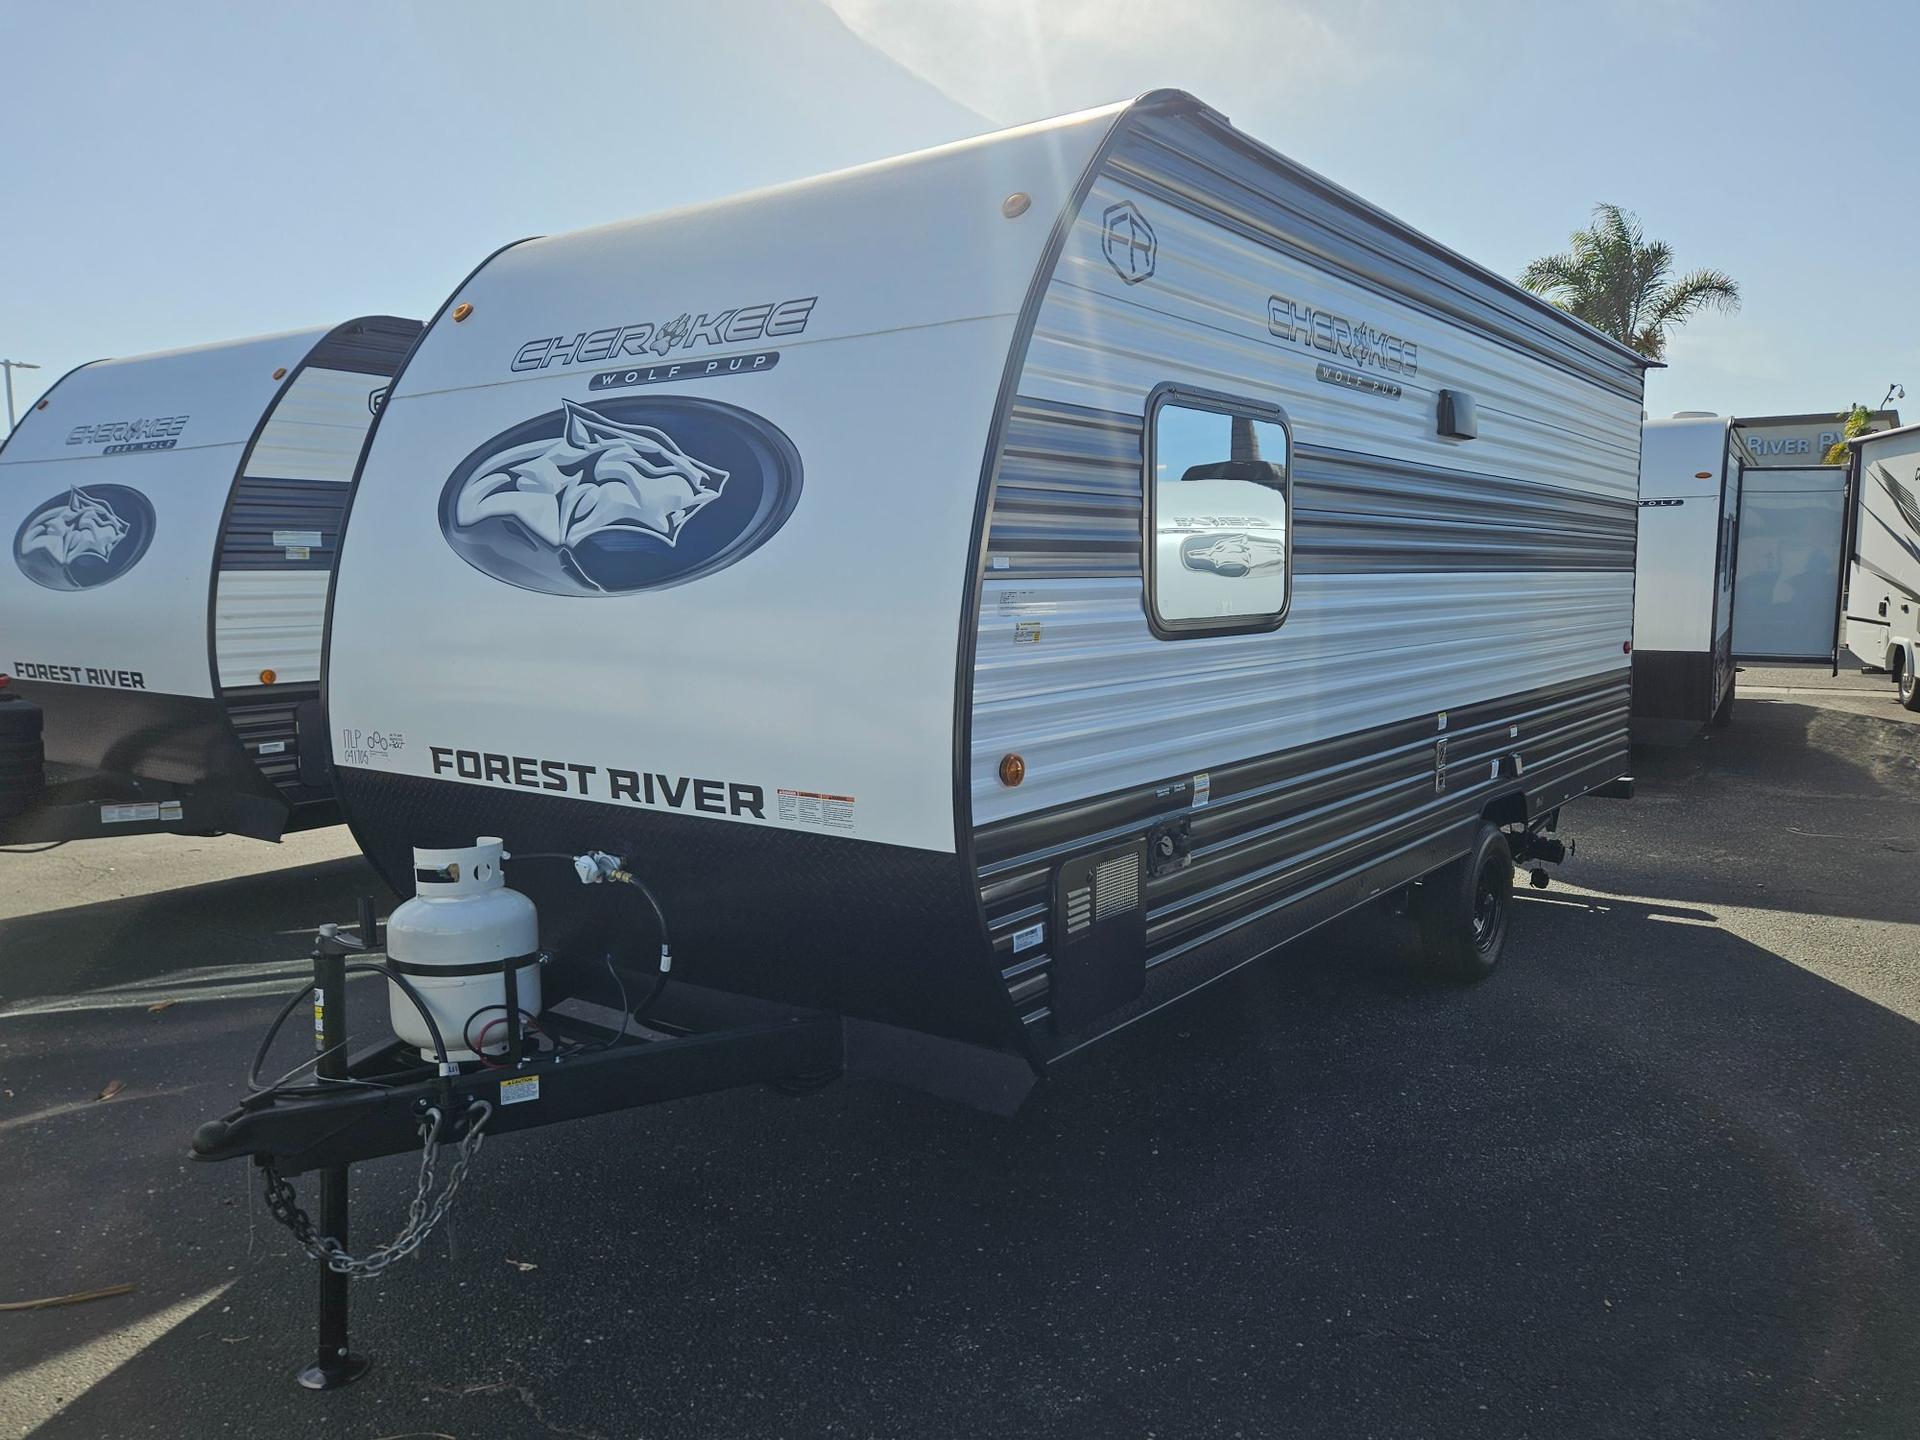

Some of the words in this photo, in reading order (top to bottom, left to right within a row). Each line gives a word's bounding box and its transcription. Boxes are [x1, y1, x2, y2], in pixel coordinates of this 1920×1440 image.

[602, 365, 681, 387] WOLF
[705, 355, 767, 373] PUP
[1322, 367, 1362, 387] WOLF
[1372, 381, 1398, 397] PUP
[1747, 436, 1809, 455] RIVER
[13, 662, 81, 683] FOREST
[85, 667, 146, 689] RIVER
[429, 746, 597, 795] FOREST
[606, 767, 767, 820] RIVER
